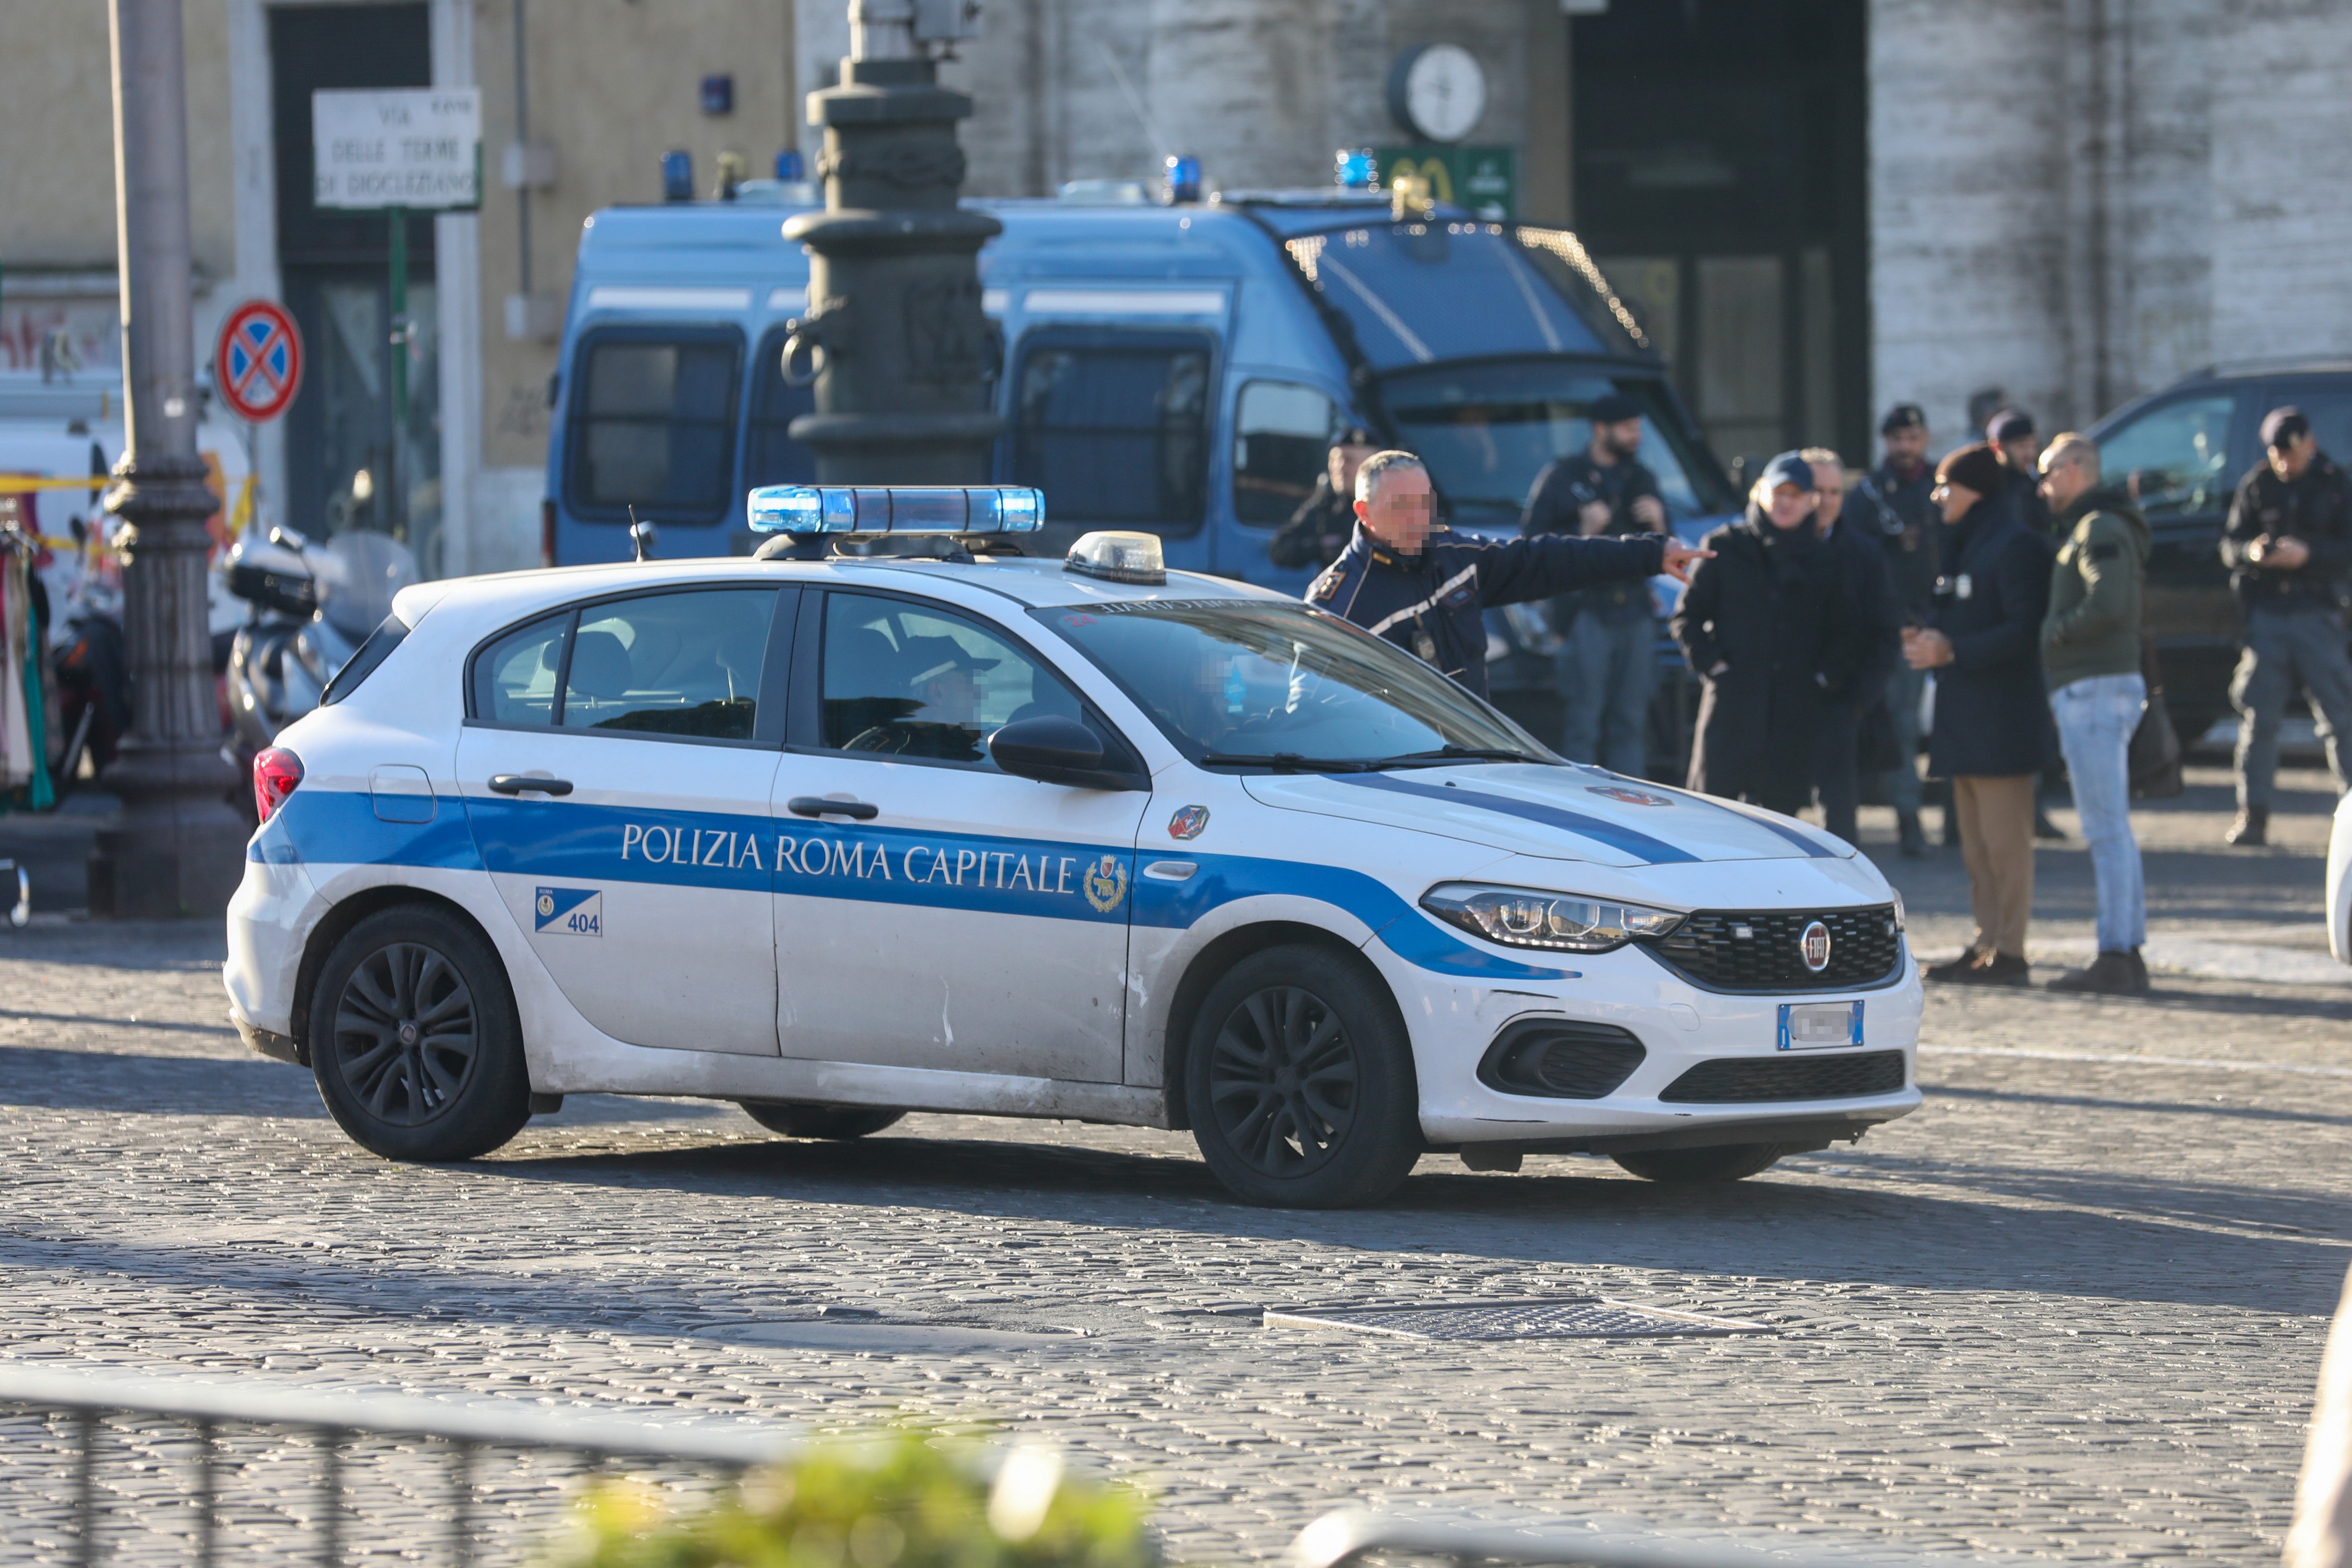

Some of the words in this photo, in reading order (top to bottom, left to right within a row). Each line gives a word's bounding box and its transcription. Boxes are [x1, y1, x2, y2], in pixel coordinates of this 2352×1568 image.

[379, 103, 410, 126] VIA
[332, 137, 385, 163] DELLE
[400, 136, 459, 163] TERME
[348, 172, 472, 196] DIOCLEZIANO
[621, 824, 764, 870] POLIZIA
[776, 835, 893, 881] ROMA
[904, 845, 1077, 894] CAPITALE
[567, 913, 599, 934] 404
[1809, 937, 1826, 959] FIAT
